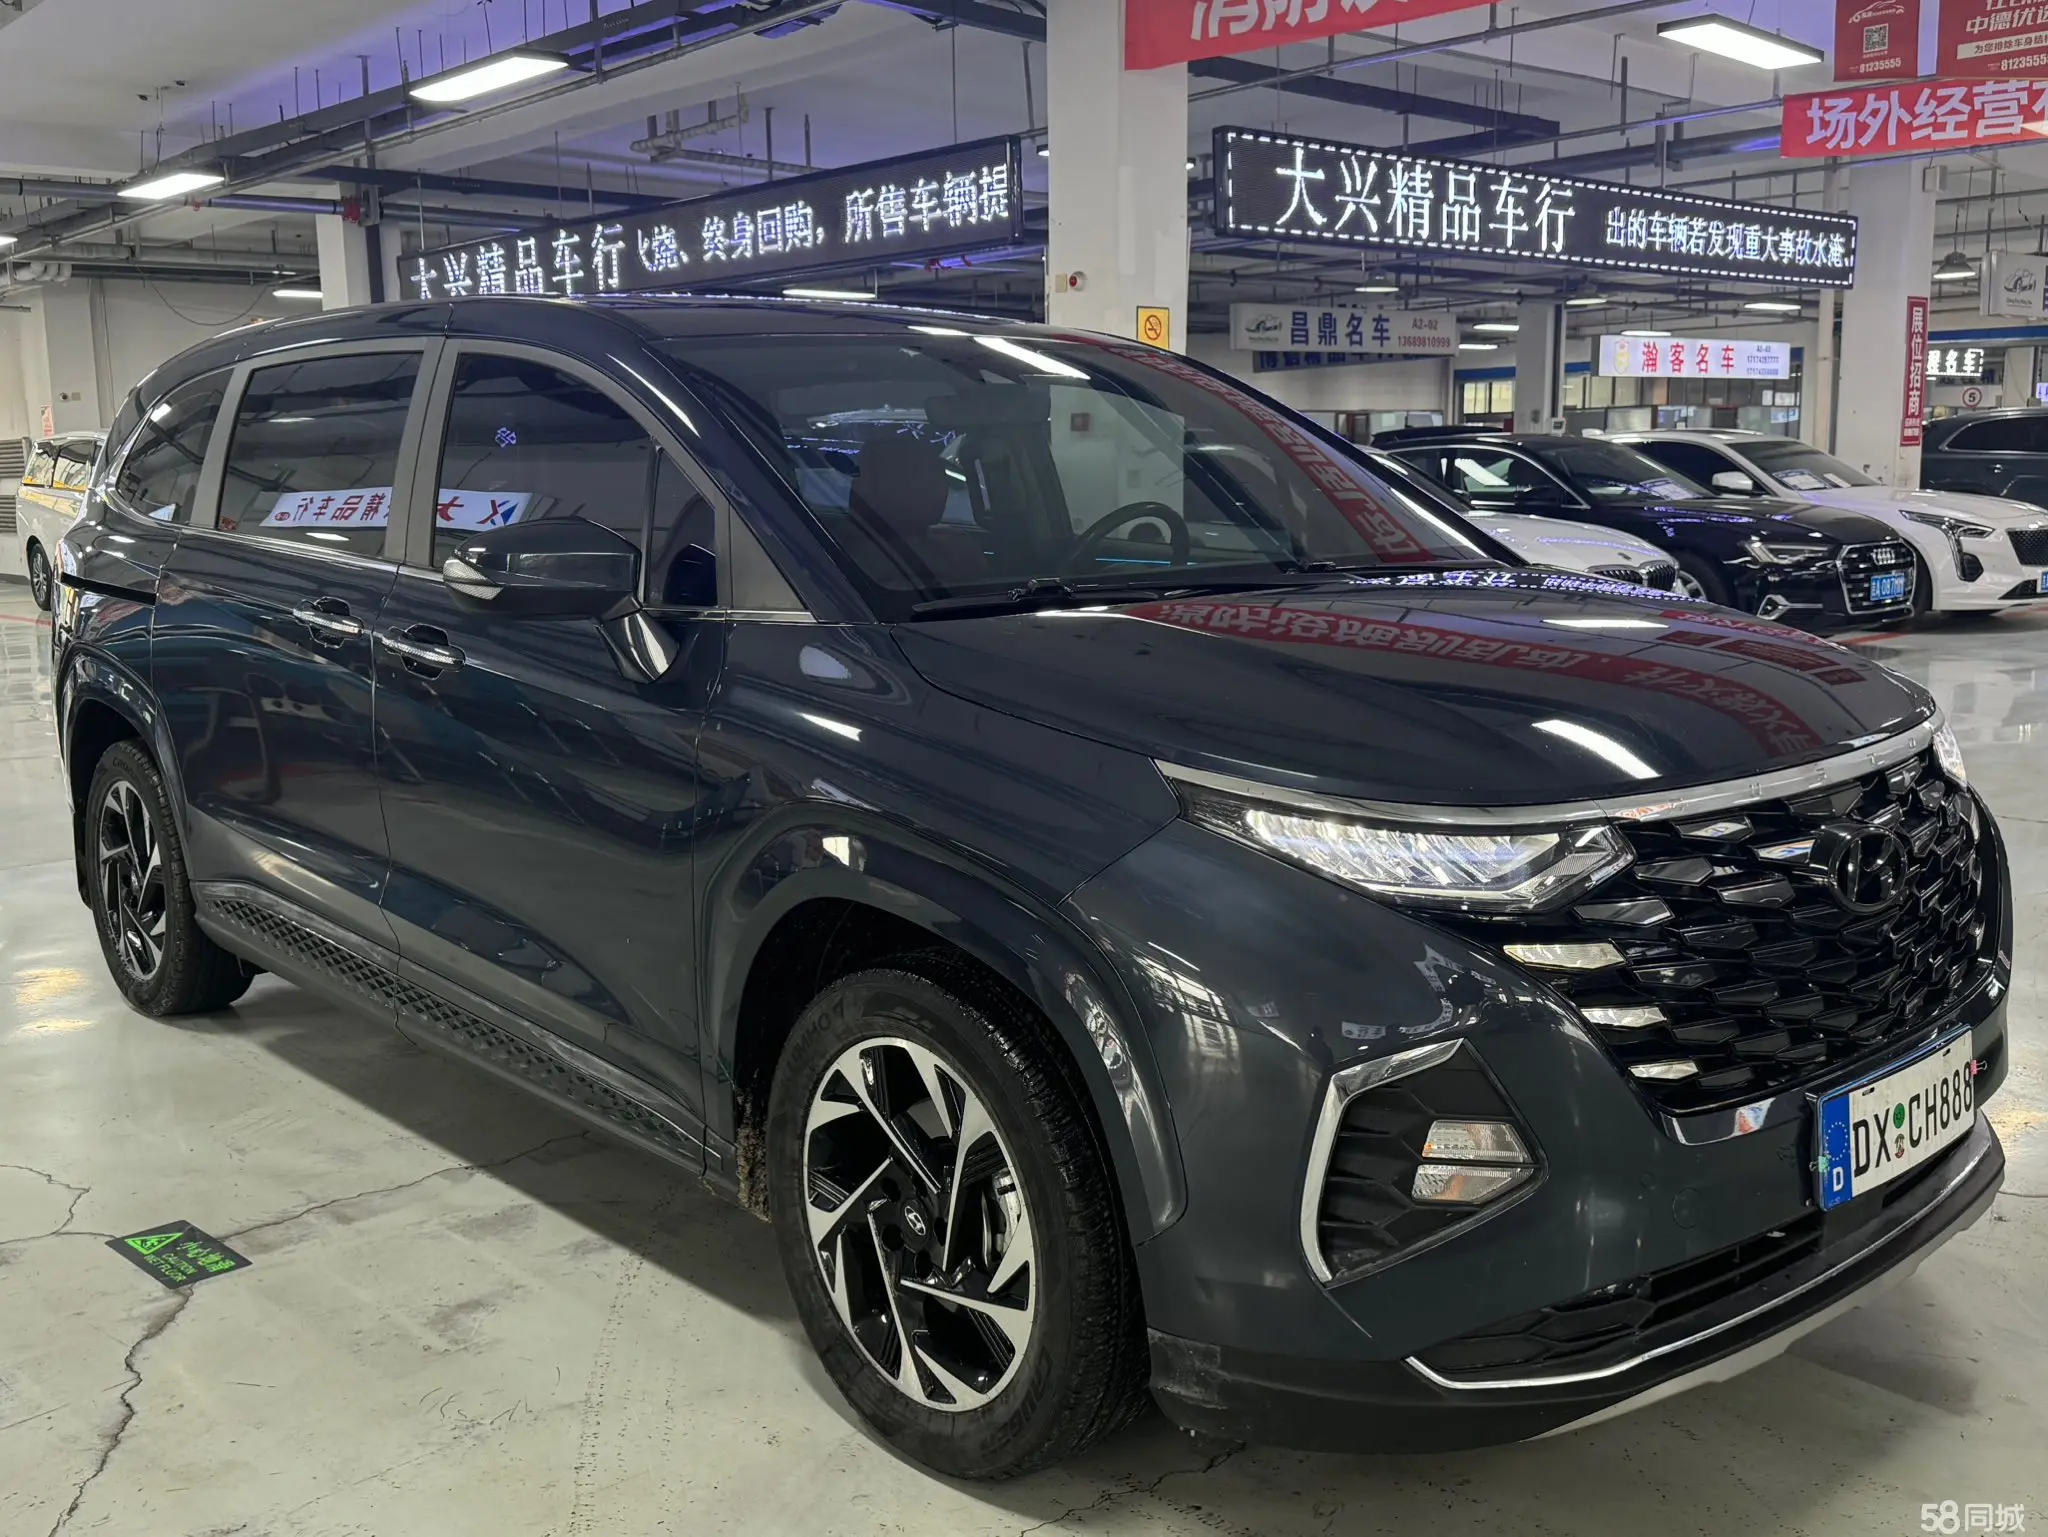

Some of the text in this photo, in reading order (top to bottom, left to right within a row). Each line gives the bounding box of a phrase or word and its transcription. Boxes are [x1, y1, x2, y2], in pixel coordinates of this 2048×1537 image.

[1973, 32, 2048, 55] 为您排除车身结
[1859, 57, 1902, 73] 81235555
[1275, 146, 1576, 253] 大兴精品车行
[1290, 310, 1391, 347] 昌鼎名车
[1907, 306, 1924, 416] 展位招商
[1852, 1061, 1974, 1178] DX CH888
[1832, 1166, 1844, 1192] D
